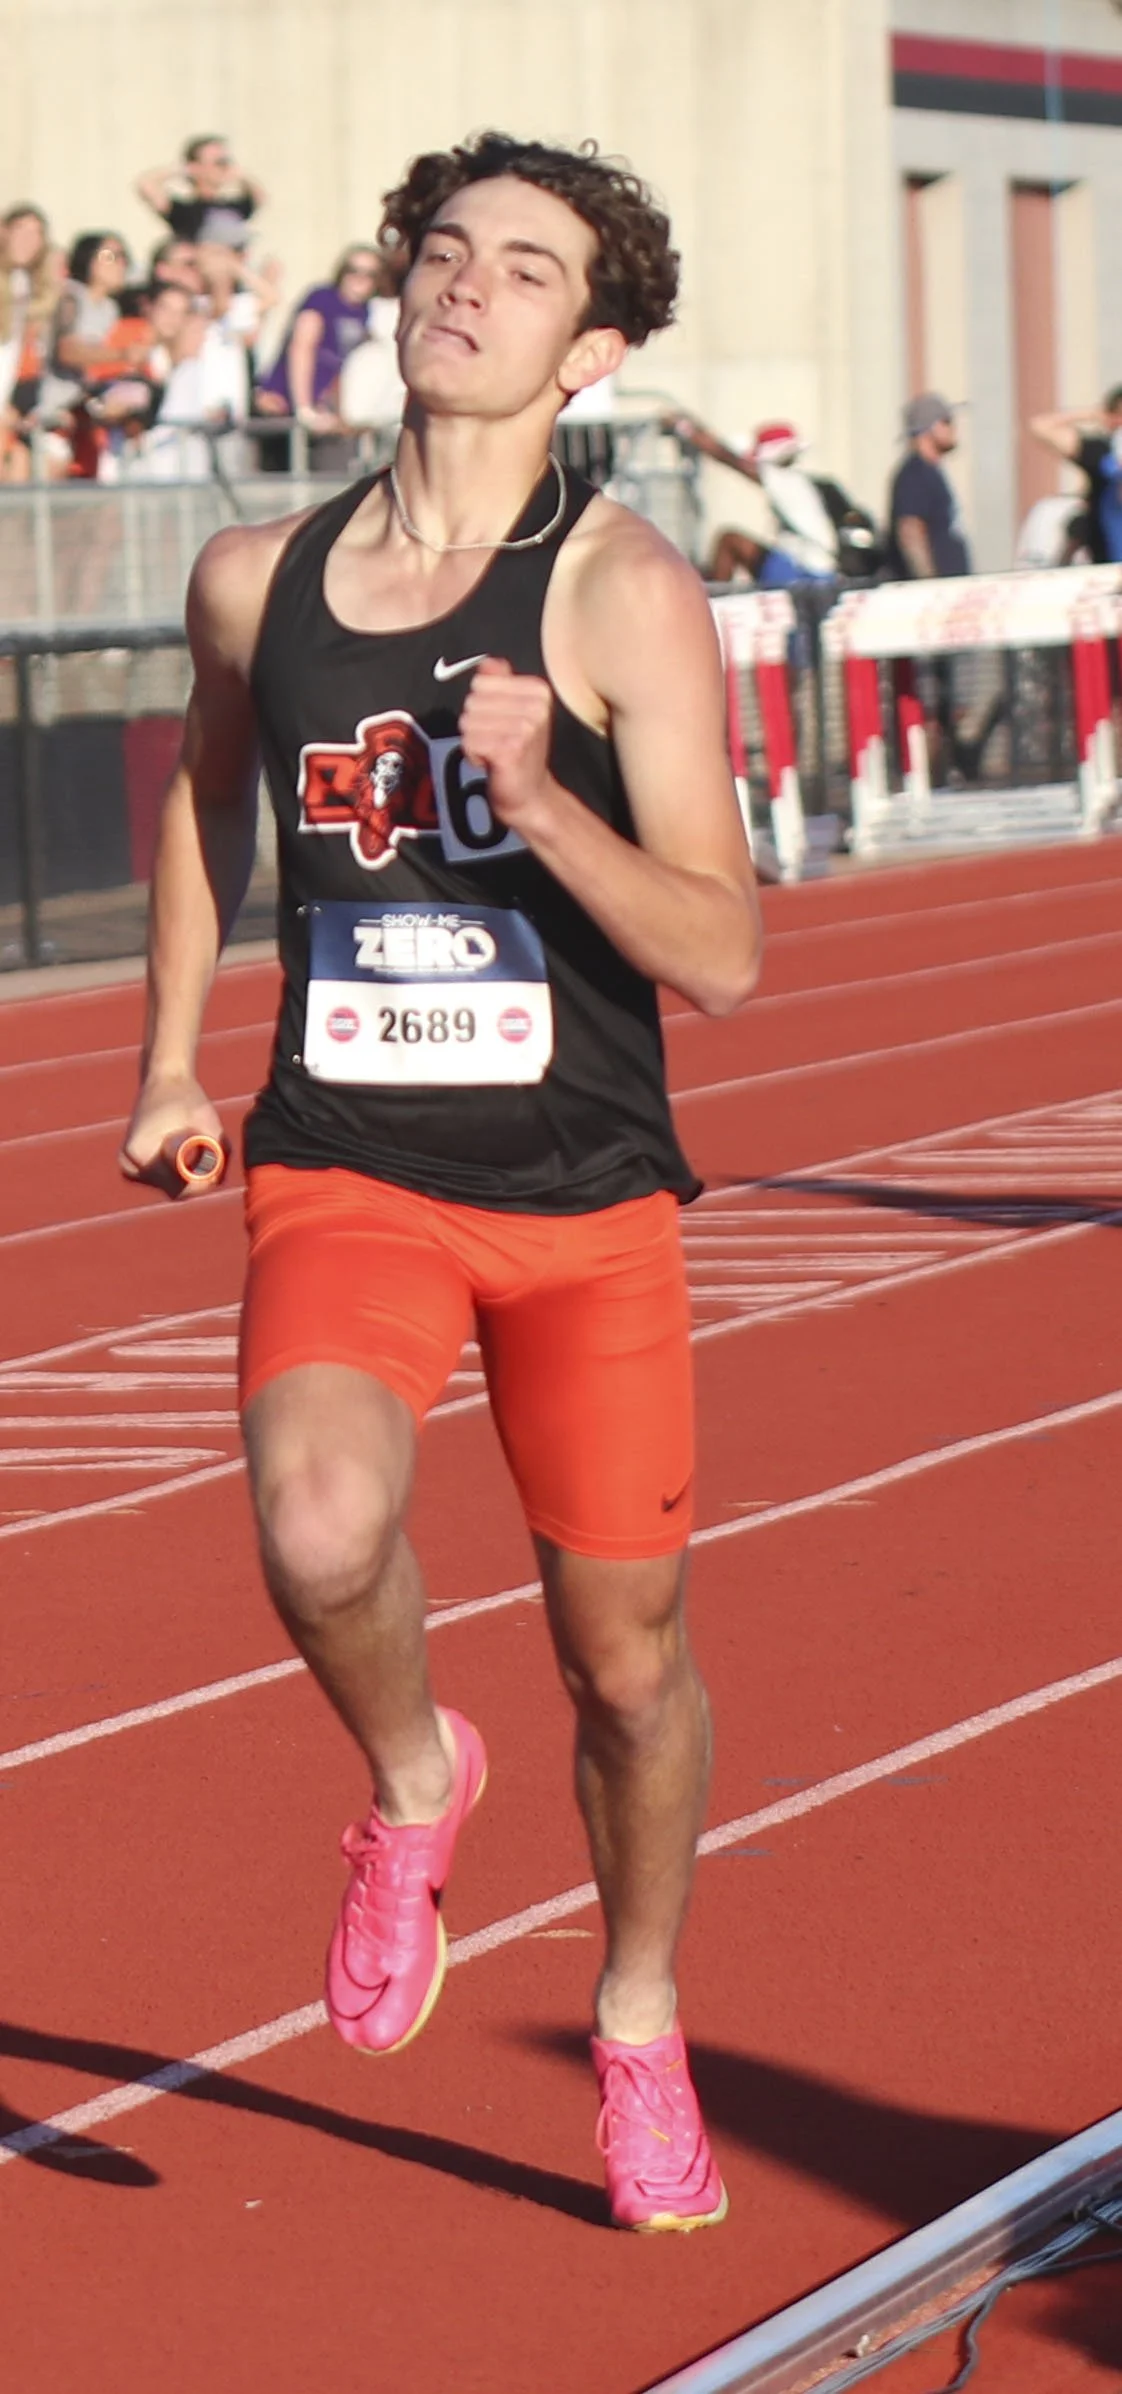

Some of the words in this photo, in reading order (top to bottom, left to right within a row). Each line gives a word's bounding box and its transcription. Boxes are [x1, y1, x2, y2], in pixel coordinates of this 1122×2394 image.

[381, 913, 461, 928] SHOW-ME
[353, 926, 497, 970] ZERO
[377, 1005, 477, 1043] 2689
